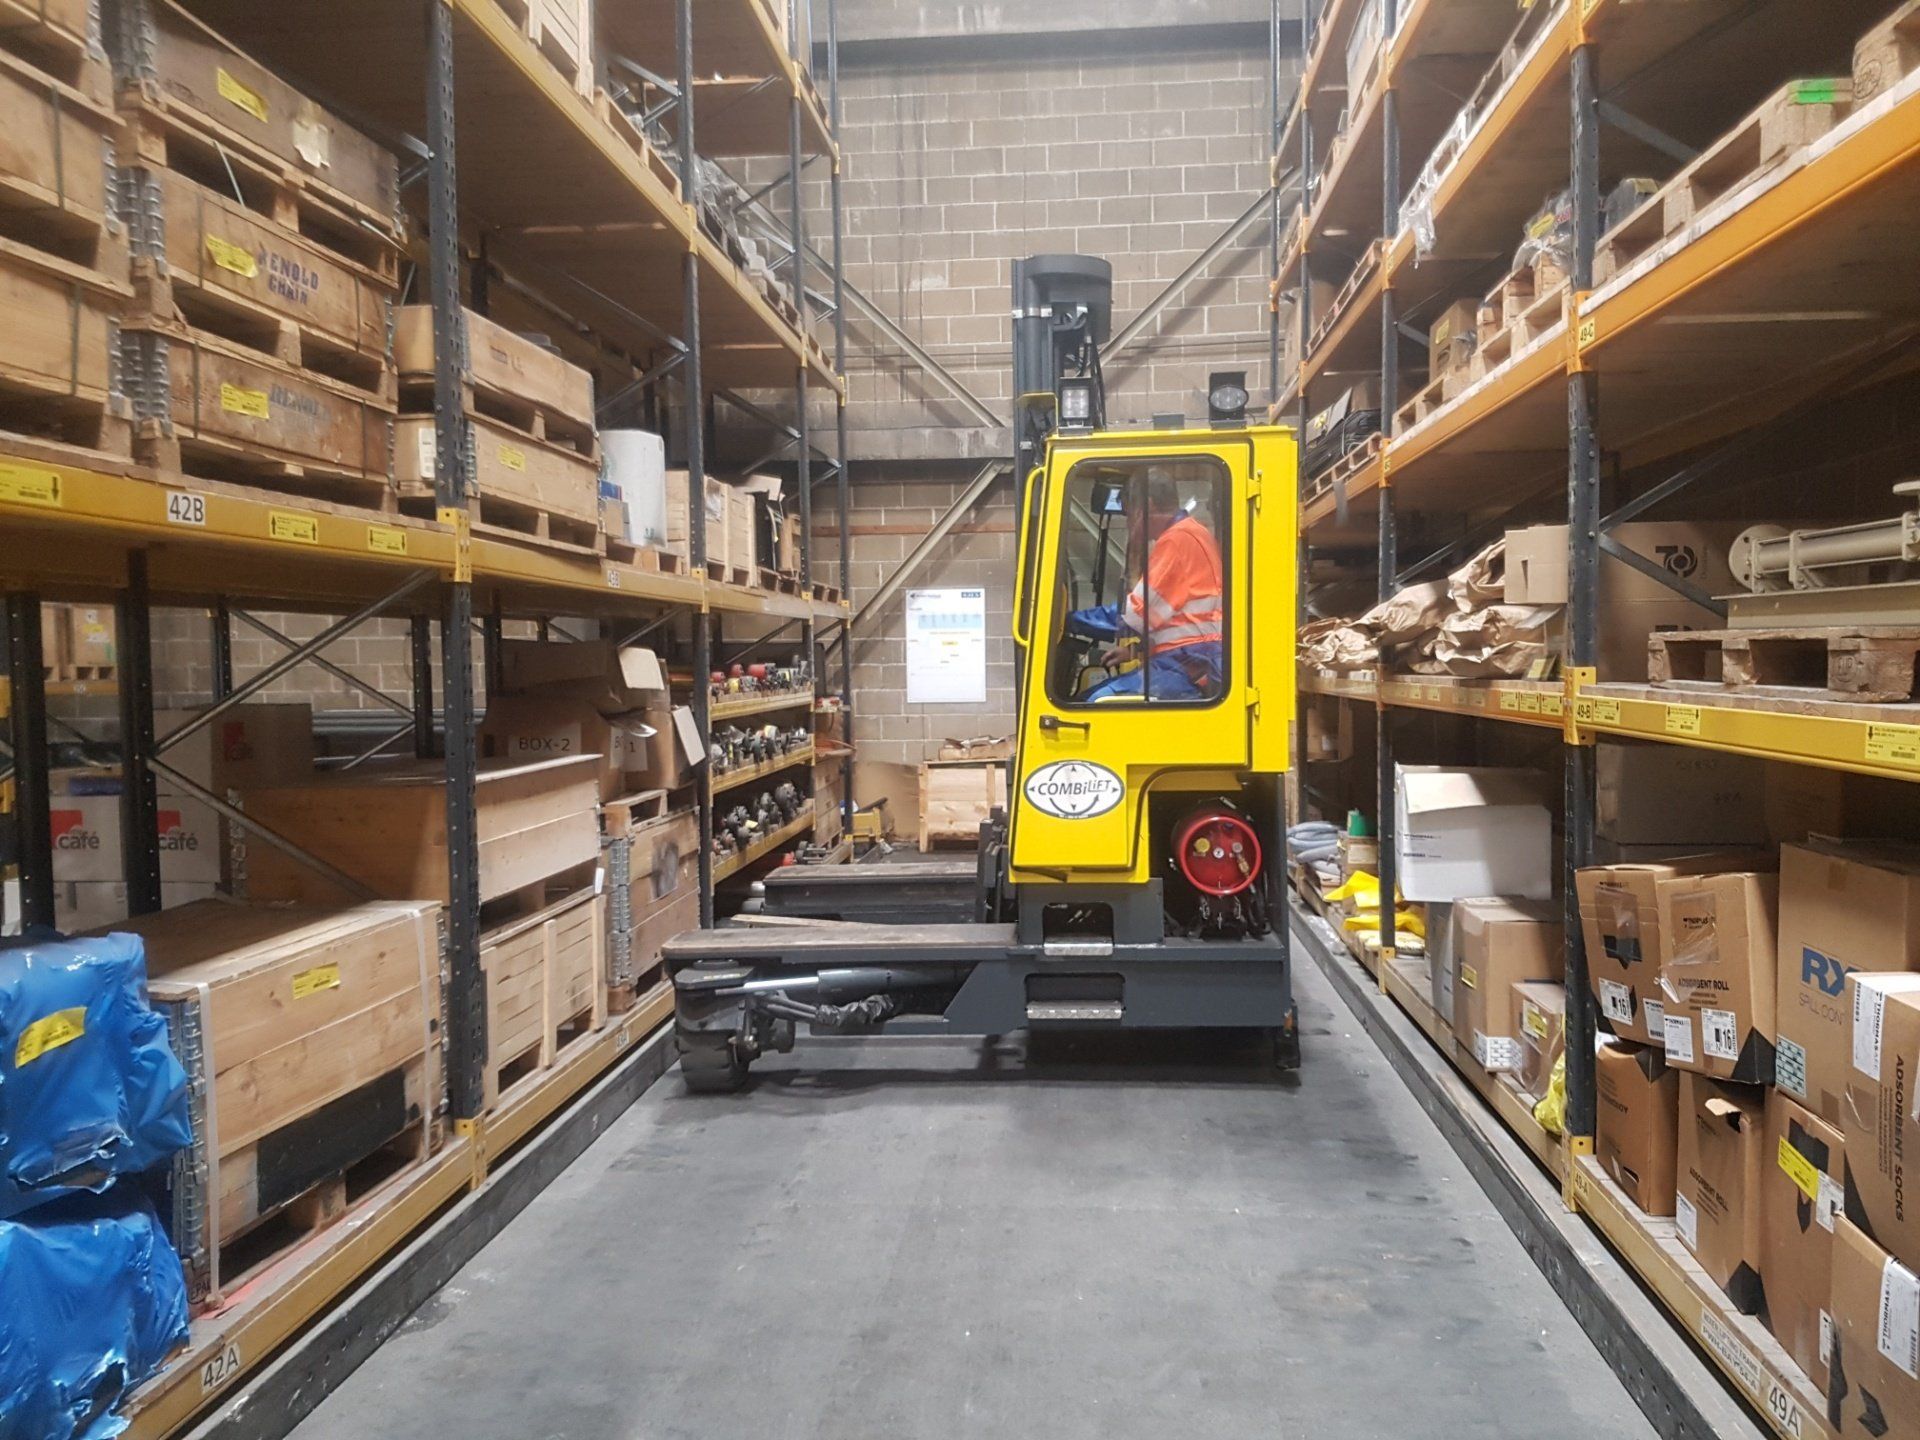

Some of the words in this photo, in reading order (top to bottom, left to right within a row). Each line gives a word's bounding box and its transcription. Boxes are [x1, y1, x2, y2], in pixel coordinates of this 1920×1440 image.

[1580, 323, 1593, 342] 49-C
[169, 494, 204, 523] 42B
[1577, 703, 1592, 719] 49-B
[519, 736, 571, 751] BOX-2
[58, 830, 100, 851] café
[1713, 979, 1730, 991] ROLL
[1894, 1054, 1906, 1163] ADSORBENT
[1893, 1164, 1905, 1223] SOCKS
[203, 1346, 239, 1388] 42A
[1768, 1386, 1800, 1438] 49A
